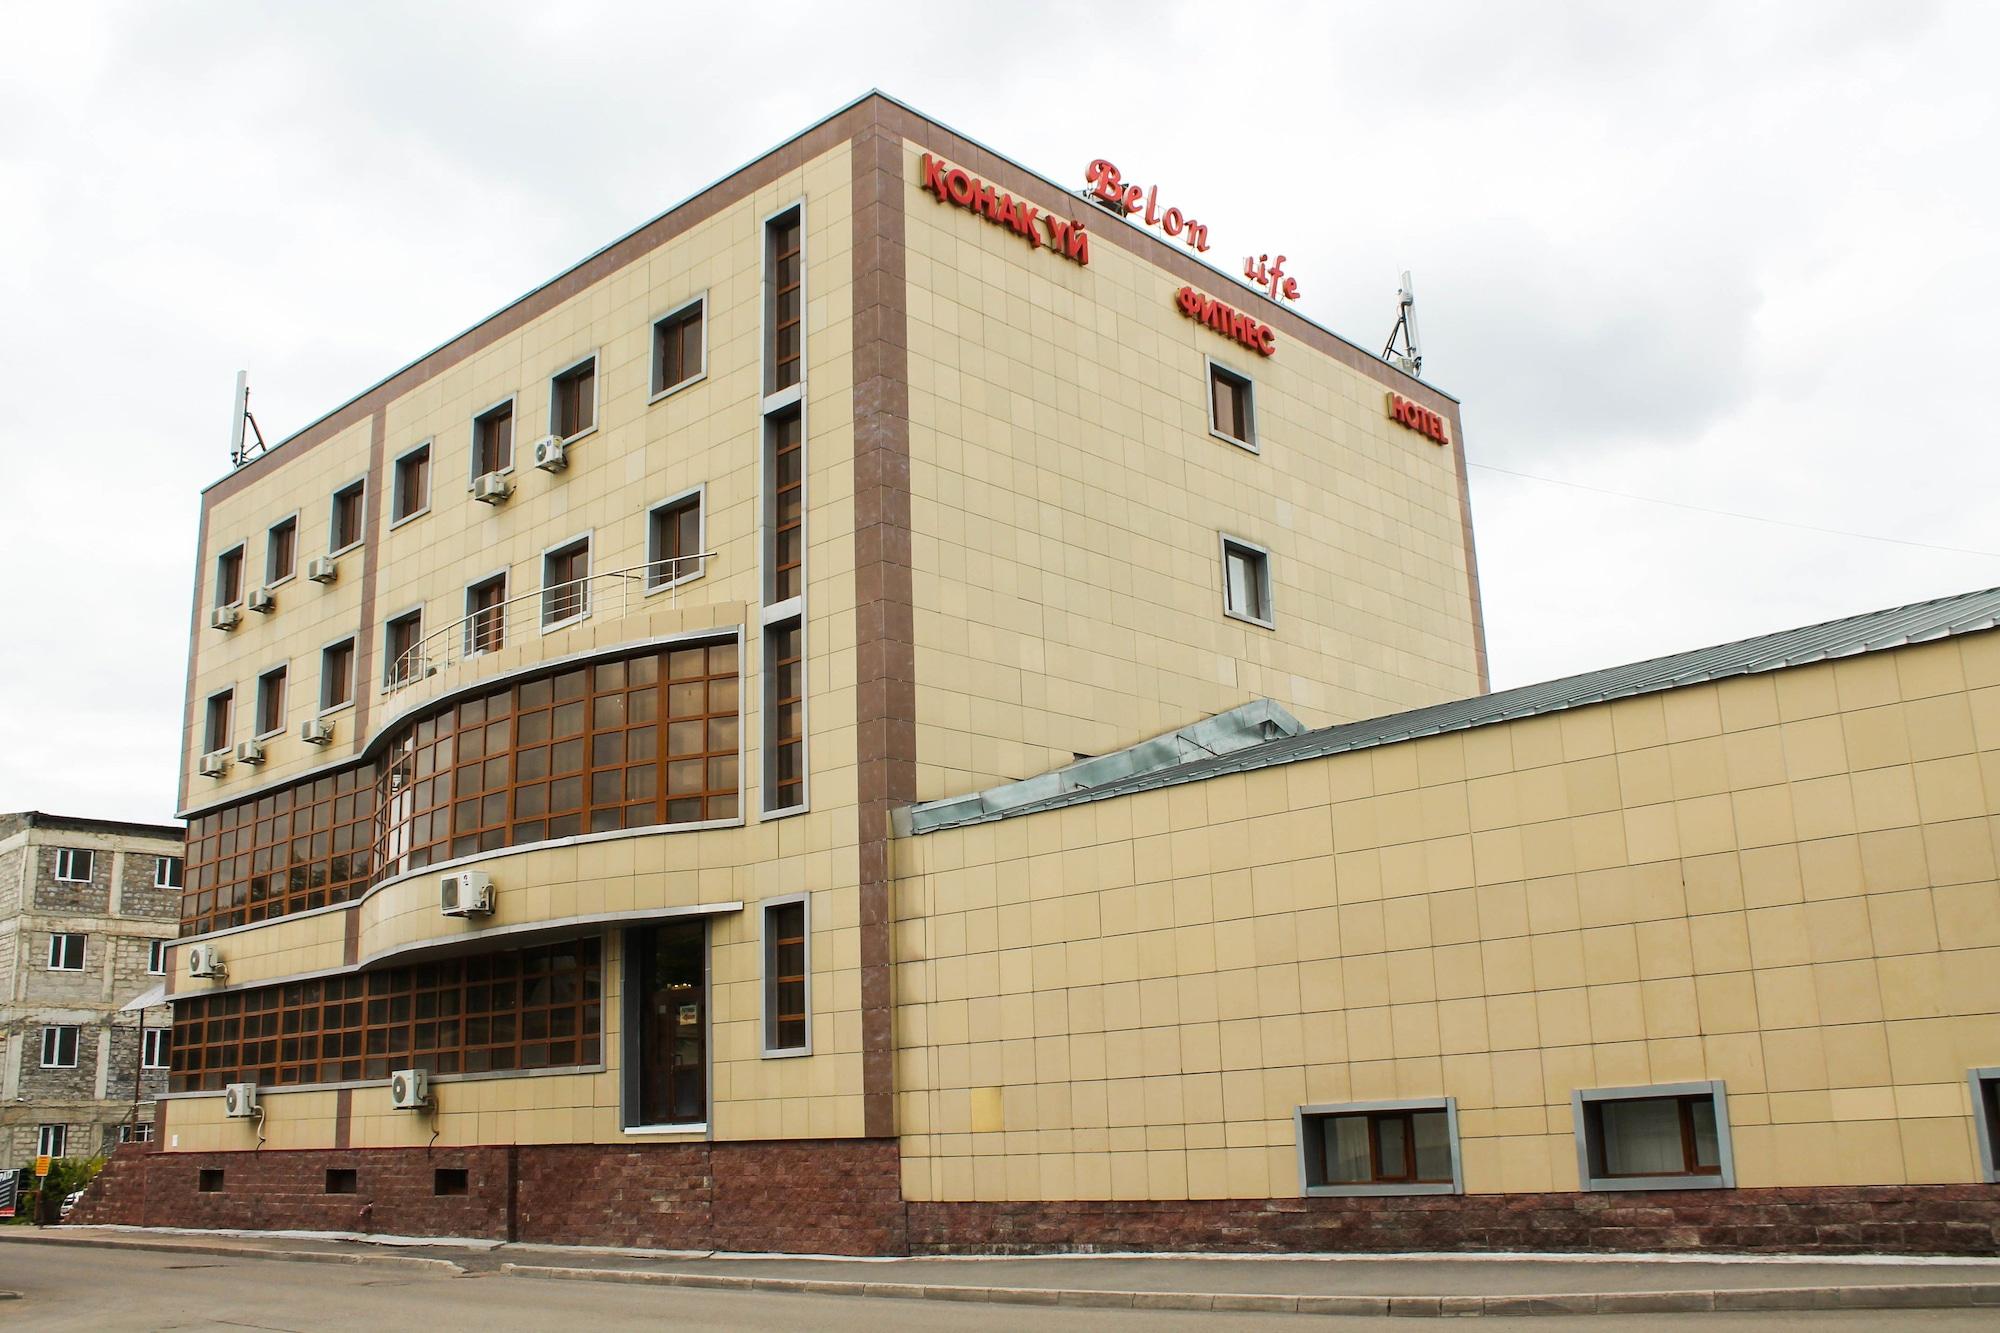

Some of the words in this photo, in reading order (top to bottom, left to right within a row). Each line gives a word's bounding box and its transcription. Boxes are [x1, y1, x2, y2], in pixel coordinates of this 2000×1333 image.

[921, 153, 1041, 248] ҚОНАҚ
[1085, 159, 1210, 252] Belon
[1176, 286, 1276, 357] ФИТНЕС
[1387, 392, 1449, 446] HOTEL
